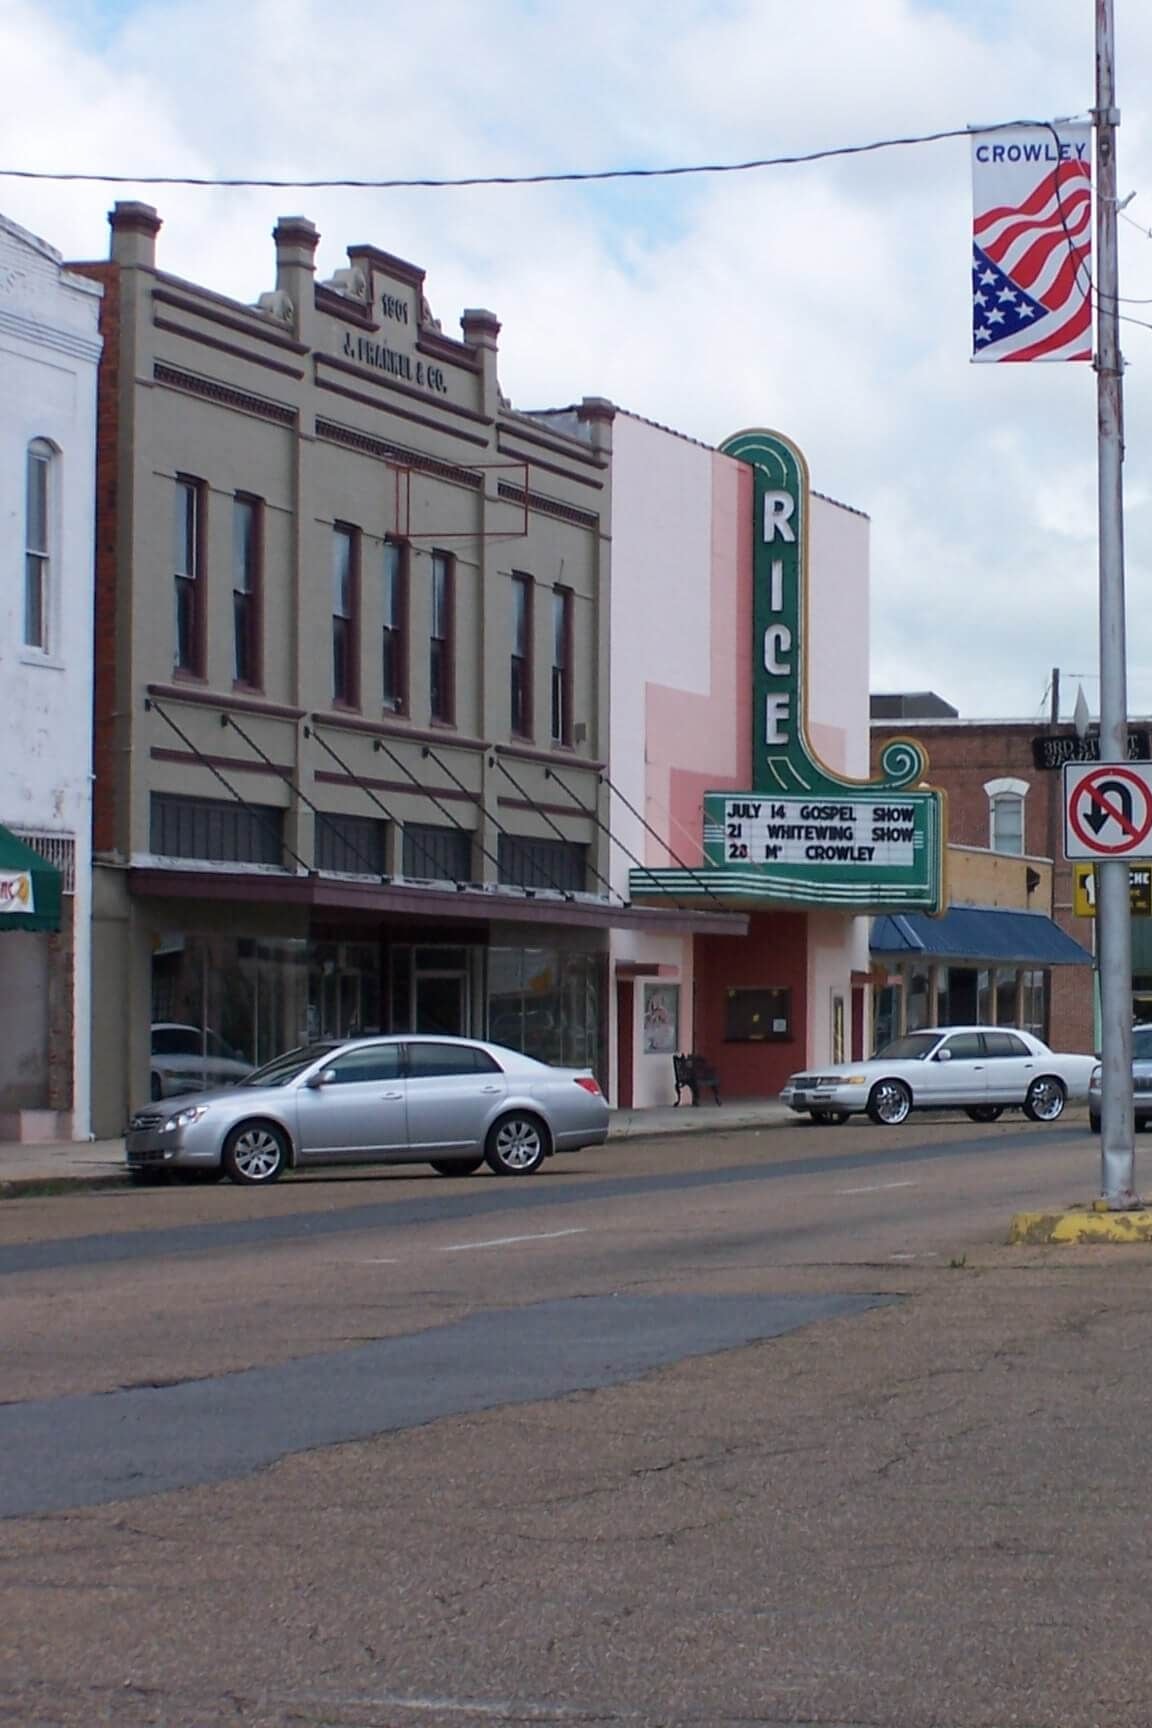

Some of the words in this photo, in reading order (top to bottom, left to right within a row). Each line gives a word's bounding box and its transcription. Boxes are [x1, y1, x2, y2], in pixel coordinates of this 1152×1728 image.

[976, 143, 1086, 162] CROWLEY
[381, 294, 408, 325] 1901
[343, 332, 355, 359] J.
[358, 337, 413, 381] FRANKEL
[416, 361, 424, 386] &
[427, 365, 447, 393] CO.
[763, 489, 796, 745] RICE
[727, 803, 762, 819] JULY
[771, 804, 786, 819] 14
[800, 805, 857, 821] GOSPEL
[872, 807, 915, 822] SHOW
[727, 824, 742, 838] 21
[767, 825, 854, 841] WHITEWING
[872, 826, 915, 842] SHOW
[729, 844, 748, 859] 28
[805, 846, 876, 862] CROWLEY
